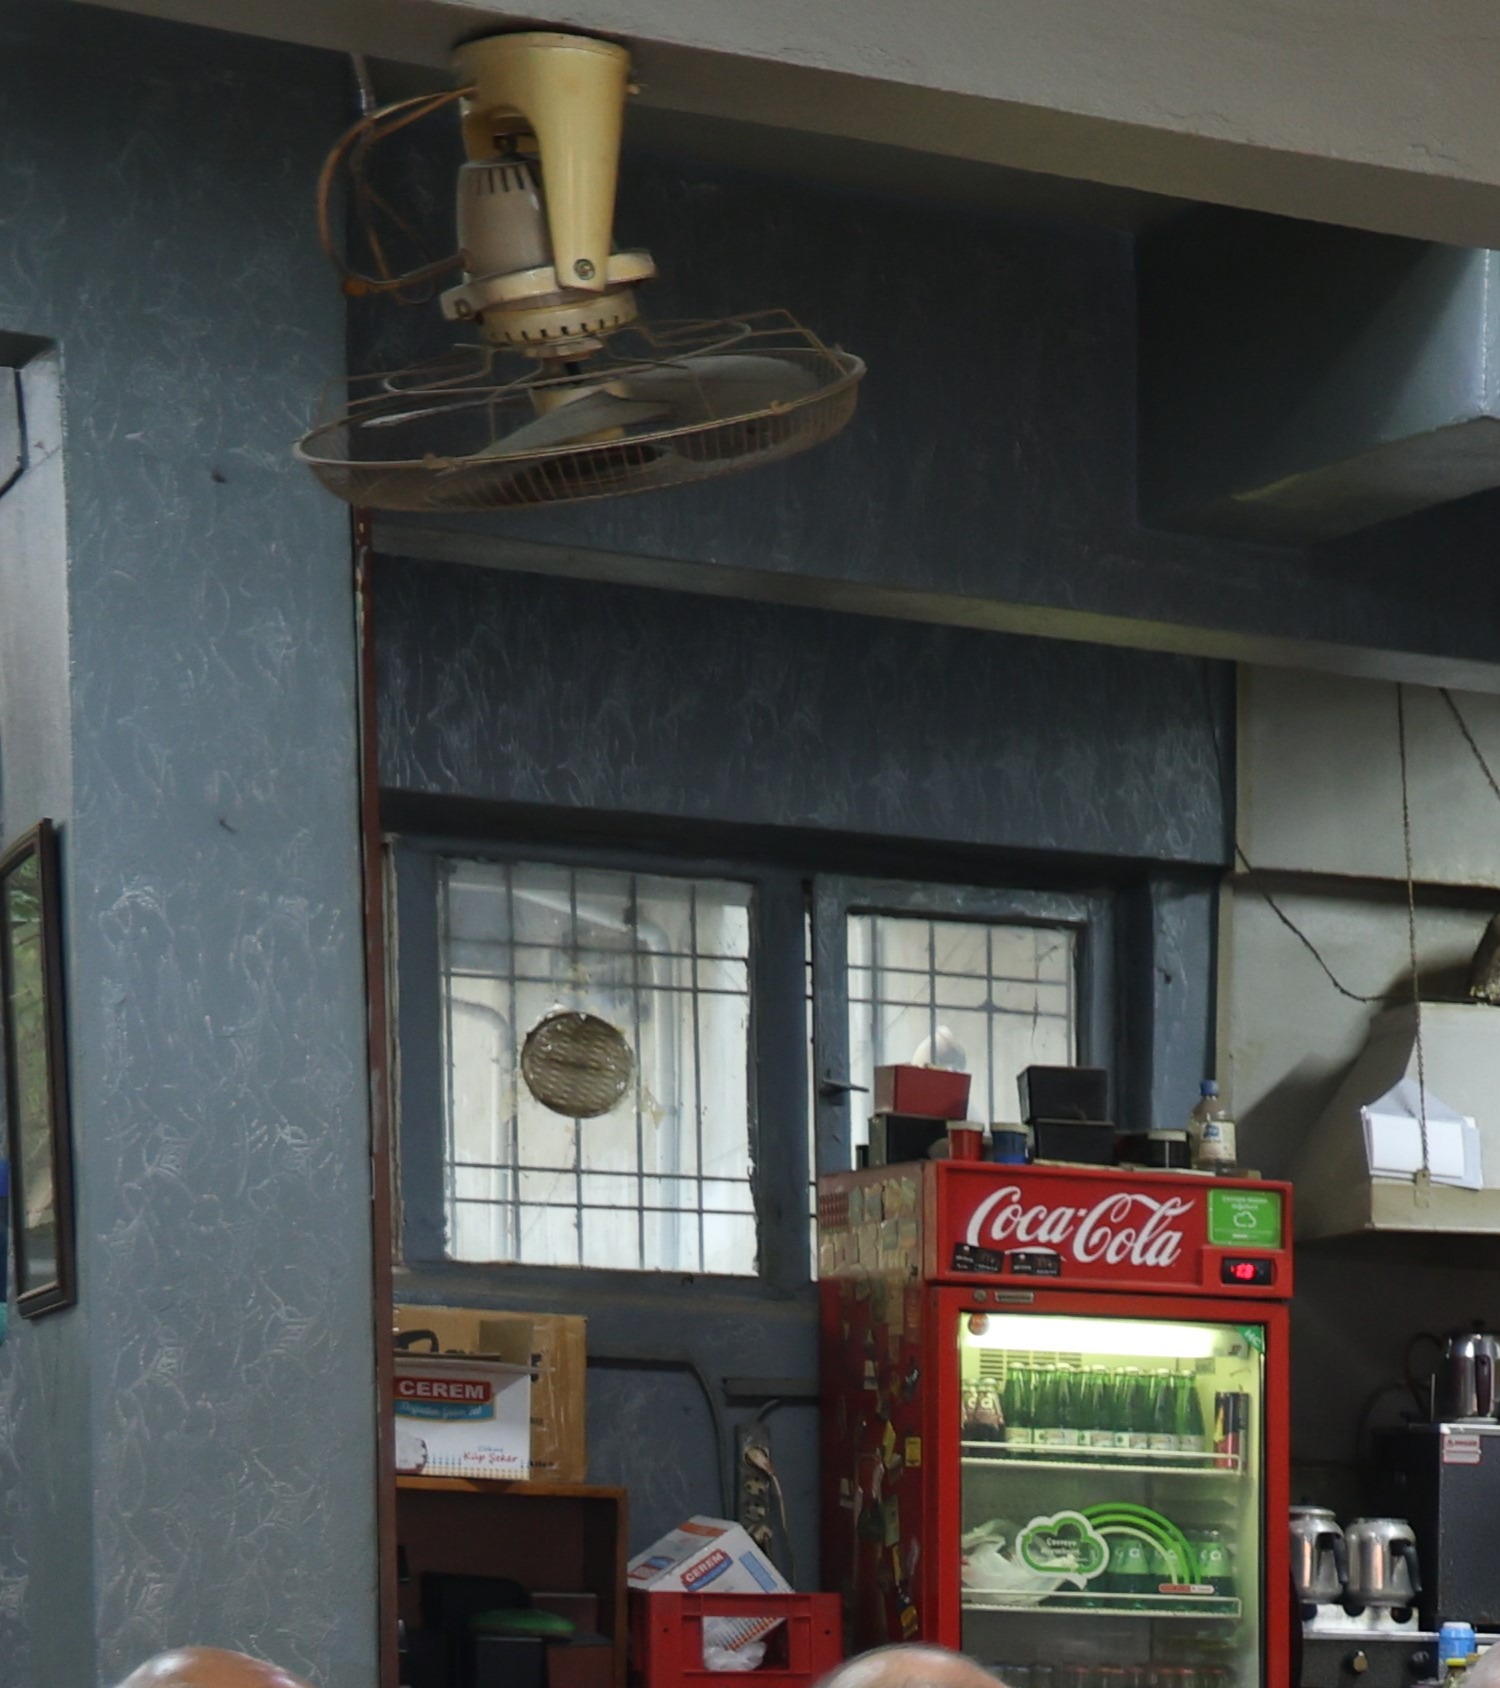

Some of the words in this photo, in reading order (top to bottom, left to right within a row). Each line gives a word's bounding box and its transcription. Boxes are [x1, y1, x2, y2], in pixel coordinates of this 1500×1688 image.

[966, 1186, 1195, 1267] Coca-Cola
[400, 1380, 484, 1399] CEREM
[685, 1552, 724, 1583] CEREM
